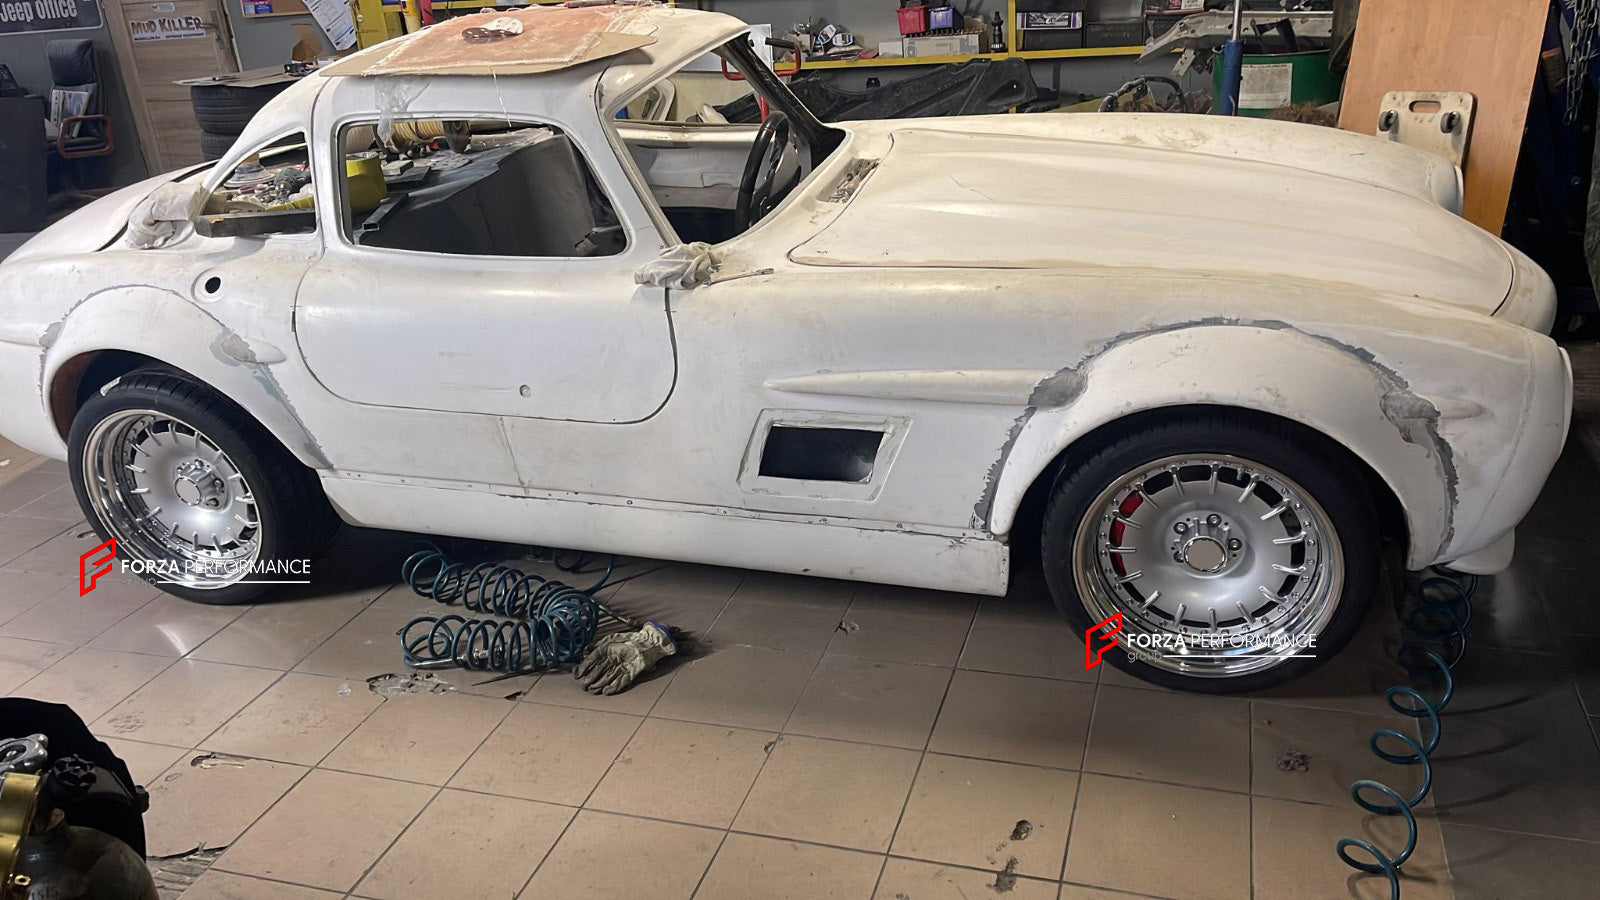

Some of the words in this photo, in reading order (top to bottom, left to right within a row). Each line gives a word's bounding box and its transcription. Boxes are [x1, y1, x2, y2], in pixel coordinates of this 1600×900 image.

[0, 1, 34, 22] Jeep
[130, 20, 157, 35] MUD
[158, 15, 202, 33] KILLER
